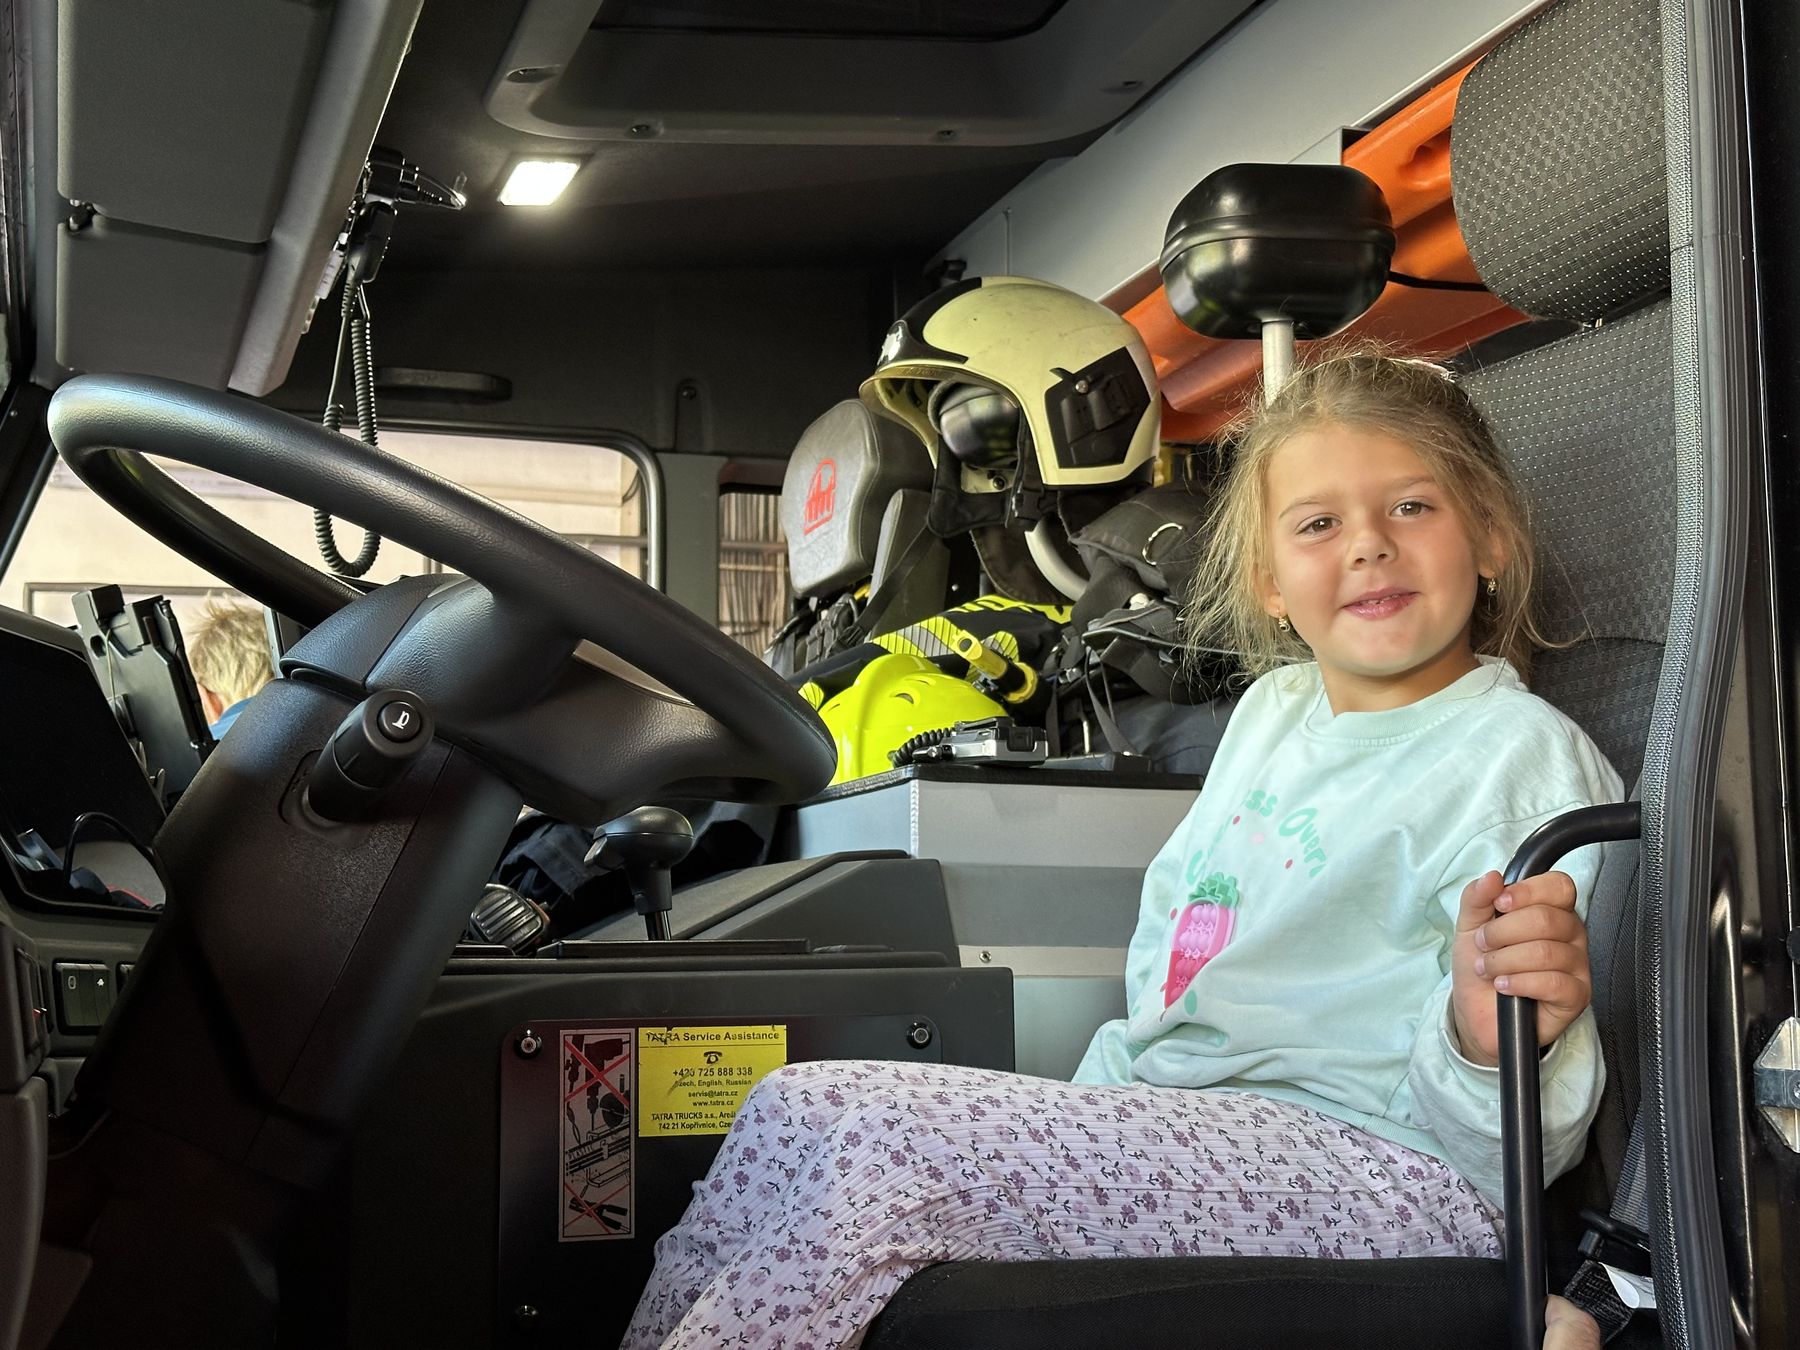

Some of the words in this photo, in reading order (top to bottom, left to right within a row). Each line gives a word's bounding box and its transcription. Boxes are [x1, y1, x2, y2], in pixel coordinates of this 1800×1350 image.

[683, 1032, 721, 1041] Service
[724, 1031, 780, 1041] Assistance
[673, 1068, 695, 1077] +420
[698, 1067, 715, 1077] 725
[717, 1067, 734, 1077] 888
[736, 1066, 753, 1076] 338
[688, 1090, 738, 1098] servis@tatra.cz
[651, 1112, 673, 1121] TATRA
[675, 1111, 703, 1120] TRUCKS
[659, 1122, 670, 1130] 742
[671, 1122, 679, 1130] 21
[680, 1120, 718, 1131] Kopřivnice,
